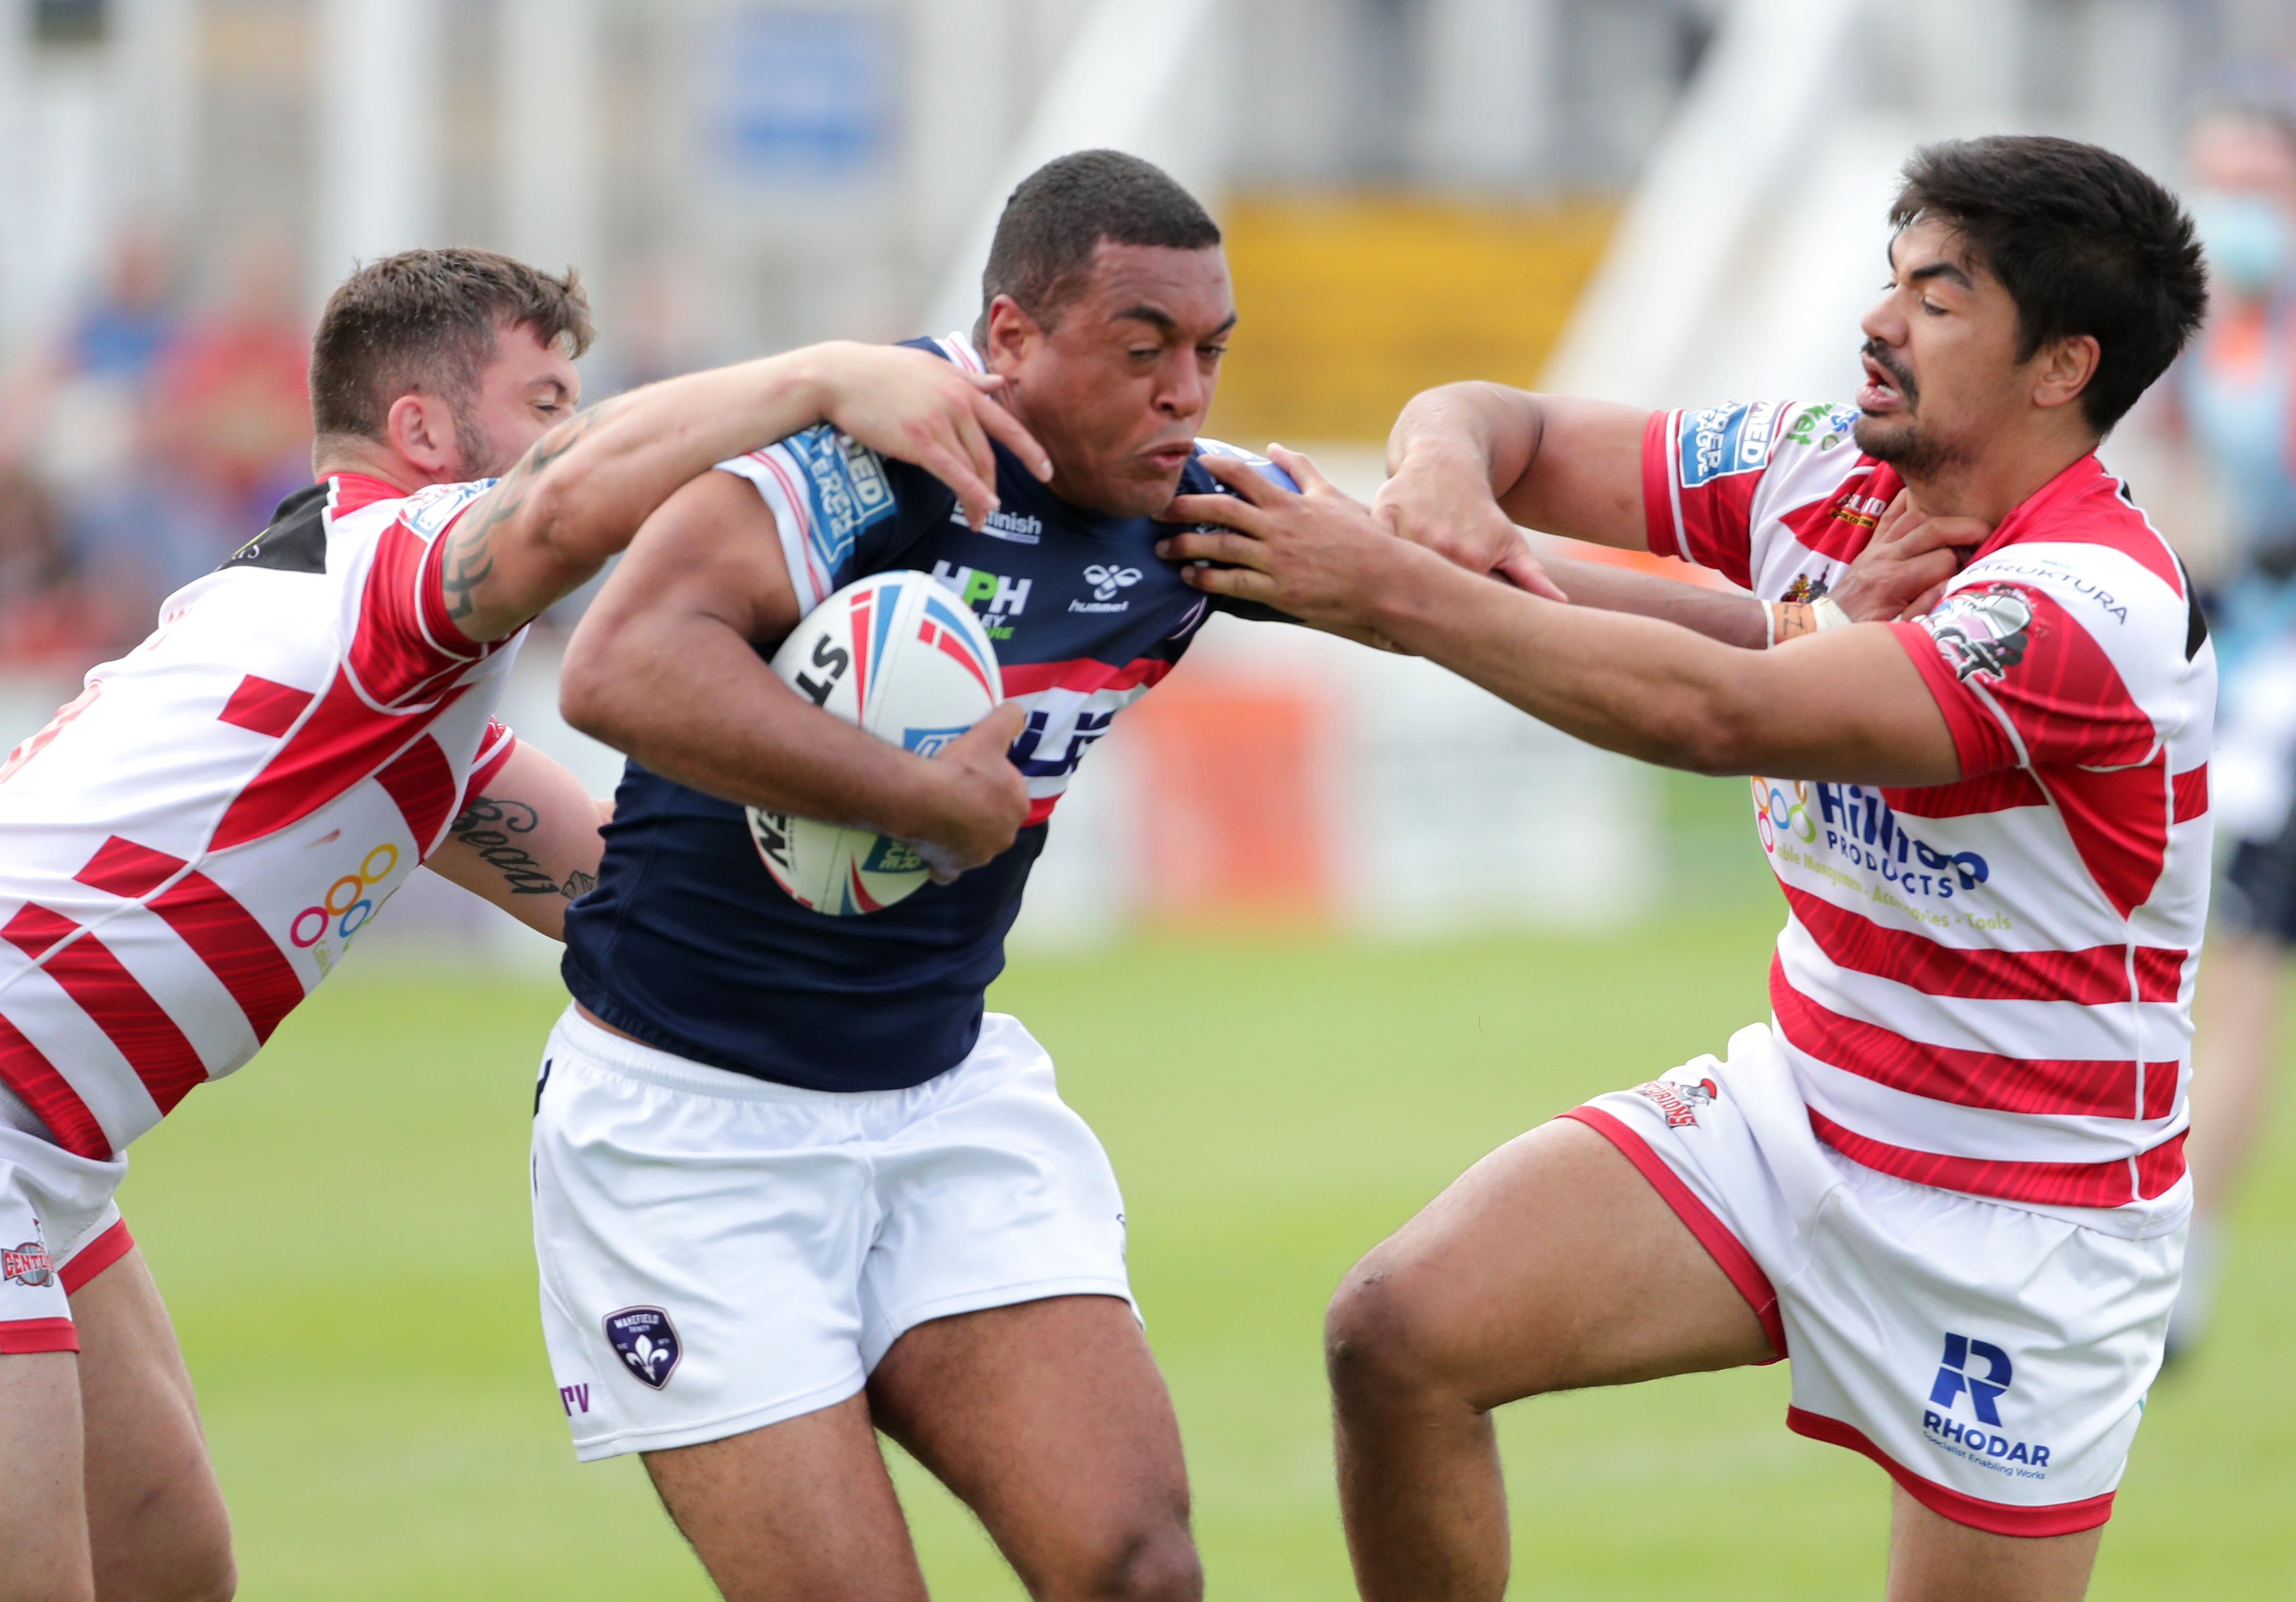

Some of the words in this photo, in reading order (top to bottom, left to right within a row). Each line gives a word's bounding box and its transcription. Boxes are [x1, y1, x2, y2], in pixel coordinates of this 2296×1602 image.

[932, 559, 1033, 616] HPH
[1067, 598, 1130, 613] hummel
[1826, 830, 1954, 898] PRODUCTS
[1962, 911, 2011, 931] Tools
[1923, 1409, 2051, 1467] RHODAR
[1969, 1454, 2014, 1476] Enabling
[2016, 1467, 2045, 1480] Works
